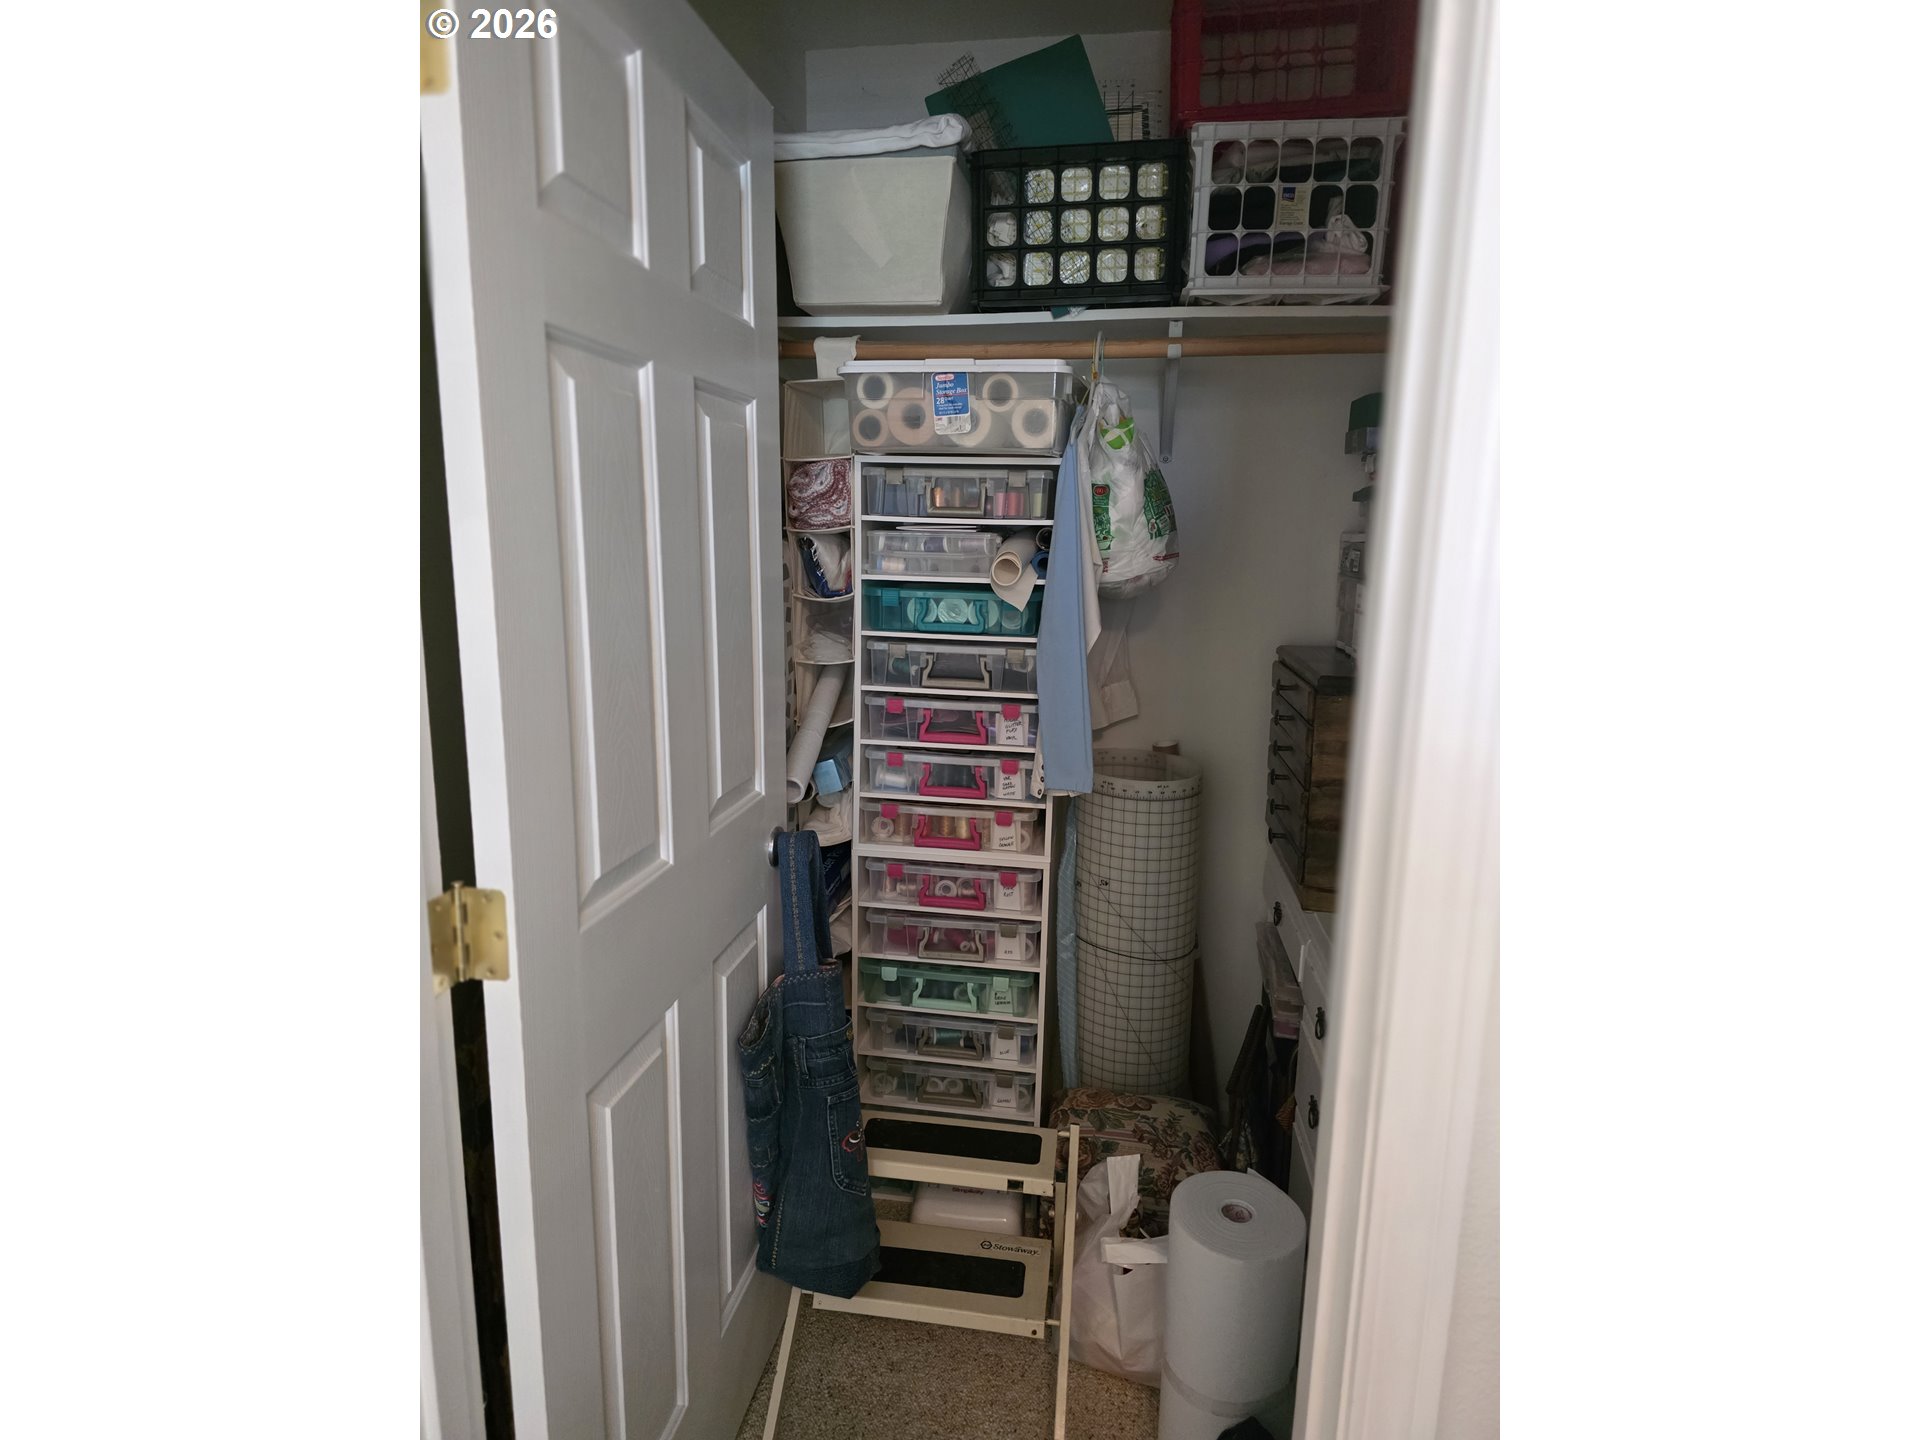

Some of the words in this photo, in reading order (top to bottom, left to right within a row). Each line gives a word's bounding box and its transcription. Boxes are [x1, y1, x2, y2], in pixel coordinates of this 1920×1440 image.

[936, 381, 954, 389] Jumbo
[936, 397, 945, 405] 28
[952, 1186, 985, 1195] Simplicity
[993, 1243, 1039, 1256] Stowaway
